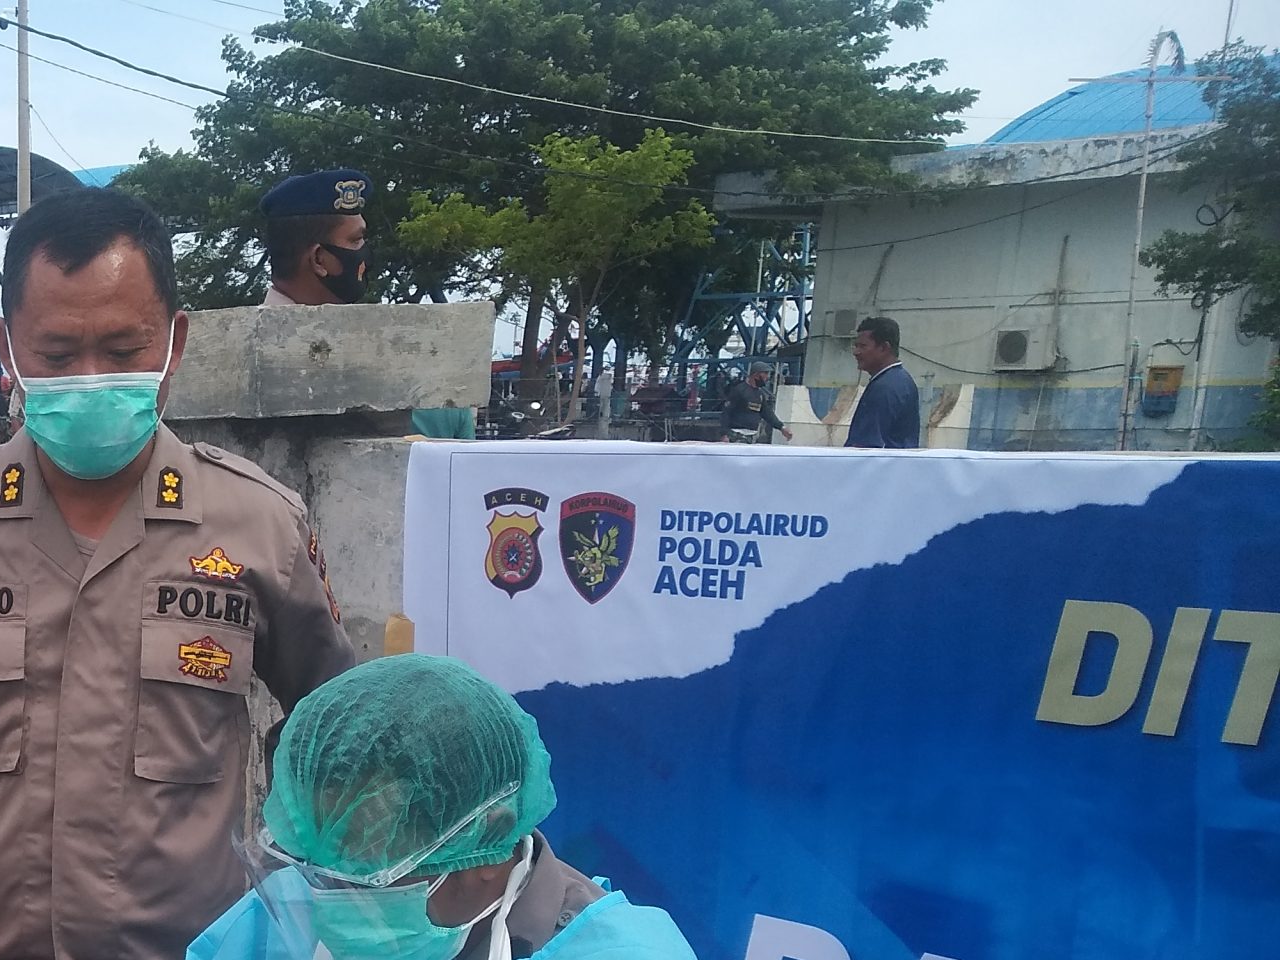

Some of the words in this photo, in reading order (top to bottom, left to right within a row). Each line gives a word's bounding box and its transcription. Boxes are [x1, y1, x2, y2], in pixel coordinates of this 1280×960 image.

[491, 492, 543, 506] ACEH
[660, 509, 829, 538] DITPOLAIRUD
[658, 536, 763, 568] POLDA
[653, 565, 746, 600] ACEH
[157, 585, 251, 627] POLRI
